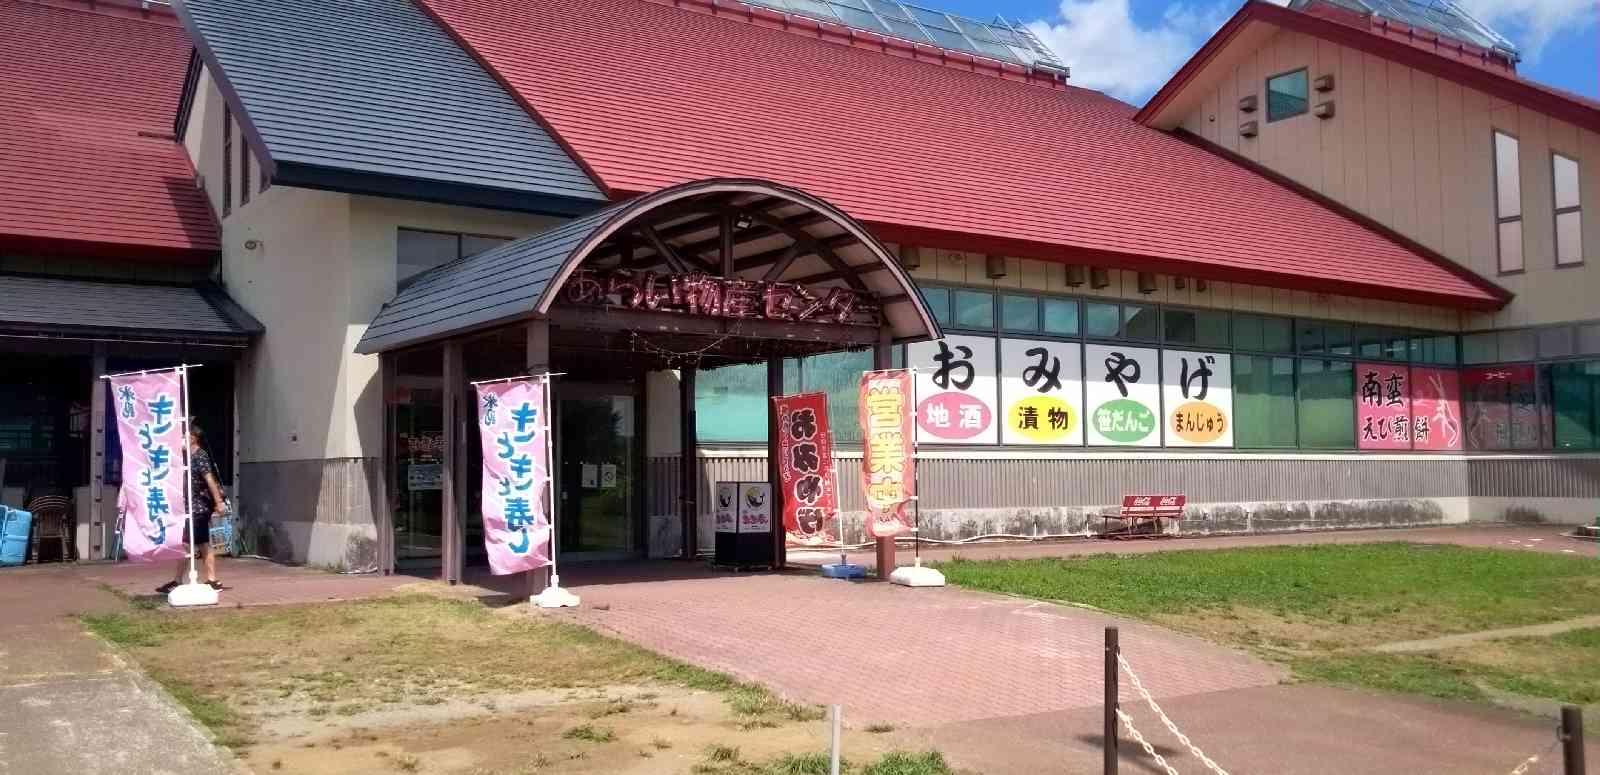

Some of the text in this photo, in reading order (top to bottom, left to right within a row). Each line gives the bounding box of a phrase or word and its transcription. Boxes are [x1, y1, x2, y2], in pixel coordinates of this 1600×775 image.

[932, 341, 1216, 400] おみやげ
[1361, 370, 1406, 407] 南蛮
[926, 404, 983, 429] 地酒
[1018, 406, 1069, 431] 漬物
[1097, 407, 1151, 433] 笹だんご
[1175, 412, 1225, 433] まんじゅう
[1362, 415, 1430, 441] えび煎餅
[791, 408, 824, 534] おみやげ
